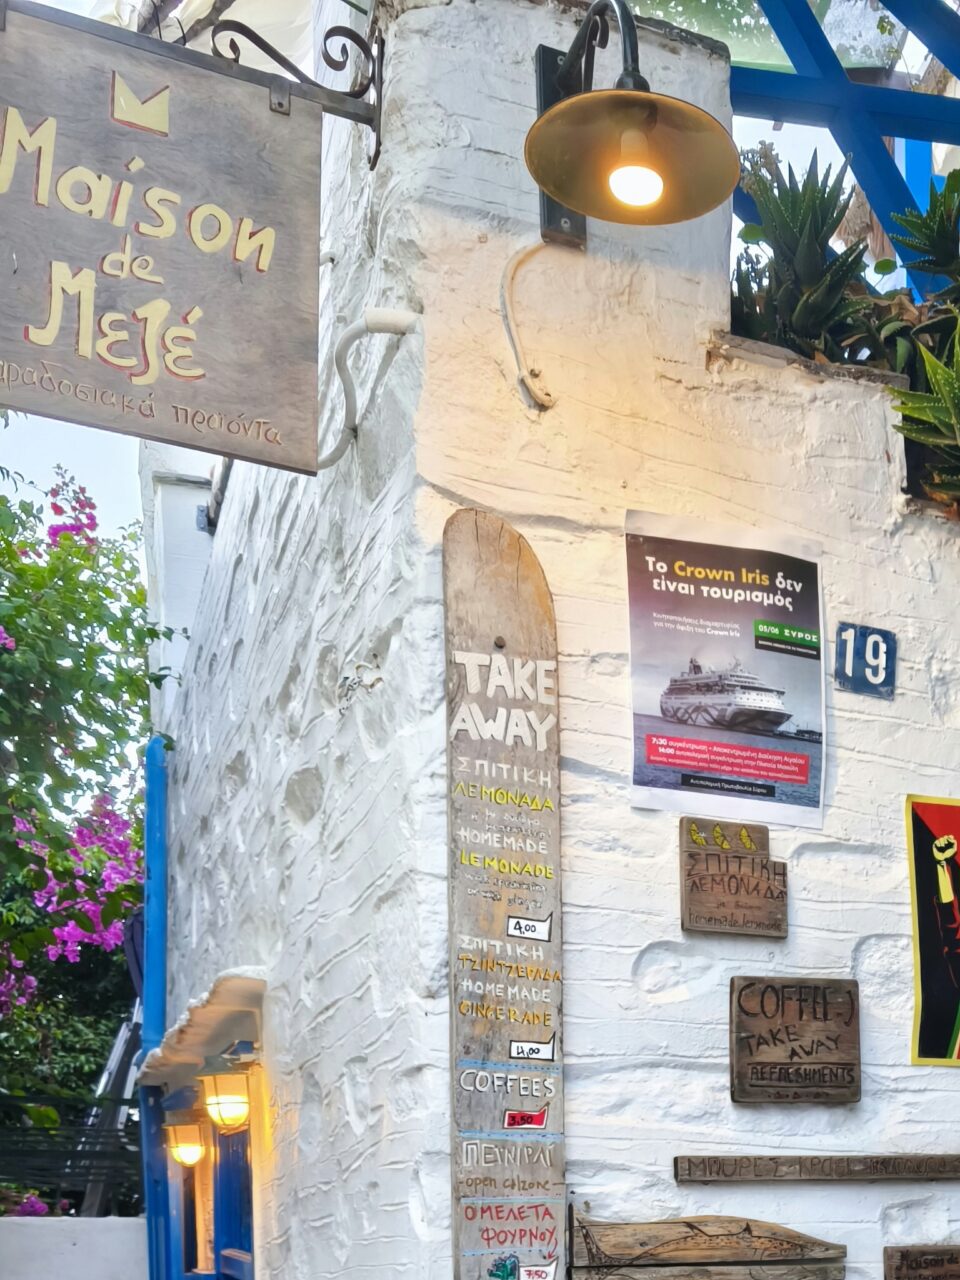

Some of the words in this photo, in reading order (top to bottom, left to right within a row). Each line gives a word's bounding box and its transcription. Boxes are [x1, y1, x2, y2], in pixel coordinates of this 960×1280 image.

[0, 105, 277, 273] Maison
[100, 233, 164, 285] de
[673, 560, 735, 583] Crown
[741, 567, 770, 587] Iris
[775, 571, 803, 593] δεν
[652, 575, 695, 596] είναι
[701, 585, 793, 612] τουρισμός
[706, 627, 729, 636] Crown
[841, 628, 887, 685] 19
[452, 650, 557, 706] TAKE
[450, 702, 557, 752] AWAY
[457, 756, 553, 789] ΣΠΙΤΙΚΗ
[453, 780, 555, 813] ΛΕΜΟΝΑΔΑ
[456, 826, 548, 855] HOMEMADE
[460, 848, 555, 880] LEMONADE
[686, 852, 787, 889] ΣΠΙΤΙΚΗ
[690, 875, 788, 901] ΛΕΜΟΝΑΔΑ
[457, 934, 544, 961] ΣΠΙΤΙΚΗ
[740, 1024, 801, 1057] TAKE
[788, 1034, 842, 1062] AWAY
[460, 1069, 556, 1098] COFFEES
[750, 1065, 856, 1085] REFRESHMENTS
[464, 1203, 555, 1221] ΟΜΕΛΕΤΑ
[480, 1225, 557, 1249] ΦΟΥΡΝΟΥ
